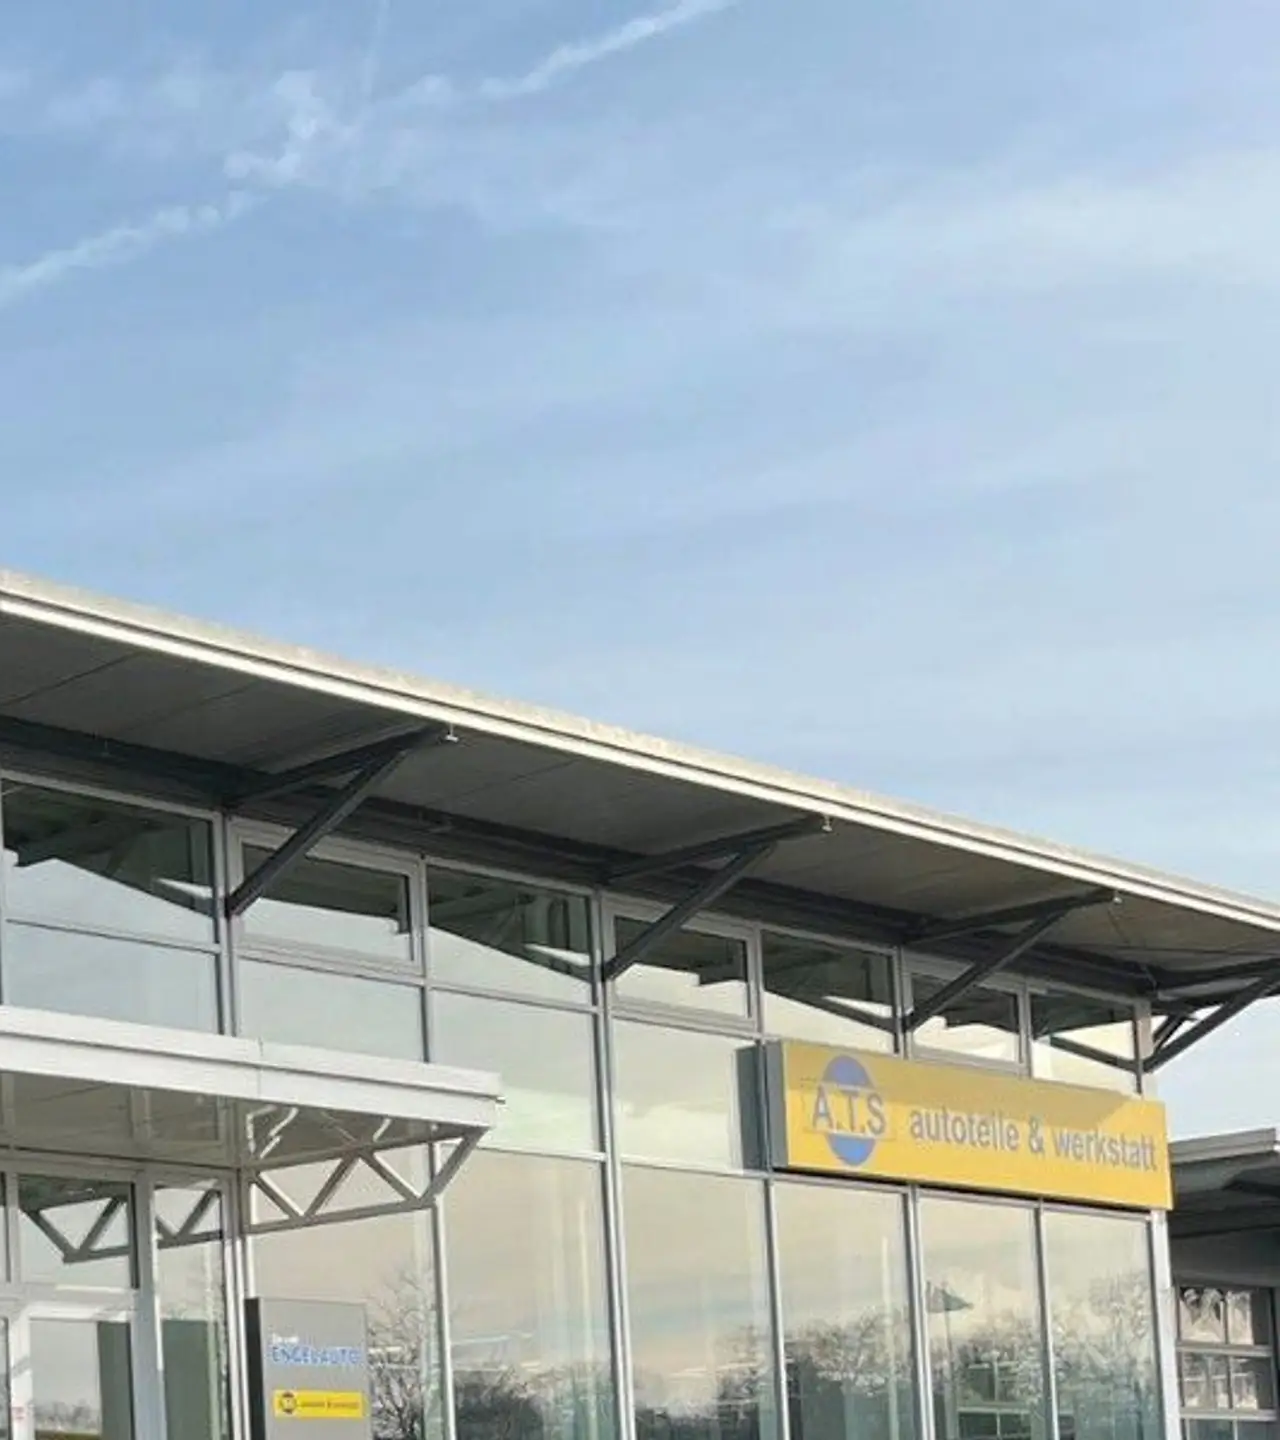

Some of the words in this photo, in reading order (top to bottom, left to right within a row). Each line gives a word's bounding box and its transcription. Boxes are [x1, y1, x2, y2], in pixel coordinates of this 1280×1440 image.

[910, 1105, 1020, 1151] autoteile
[1028, 1115, 1045, 1155] &
[1051, 1128, 1157, 1171] werkstatt
